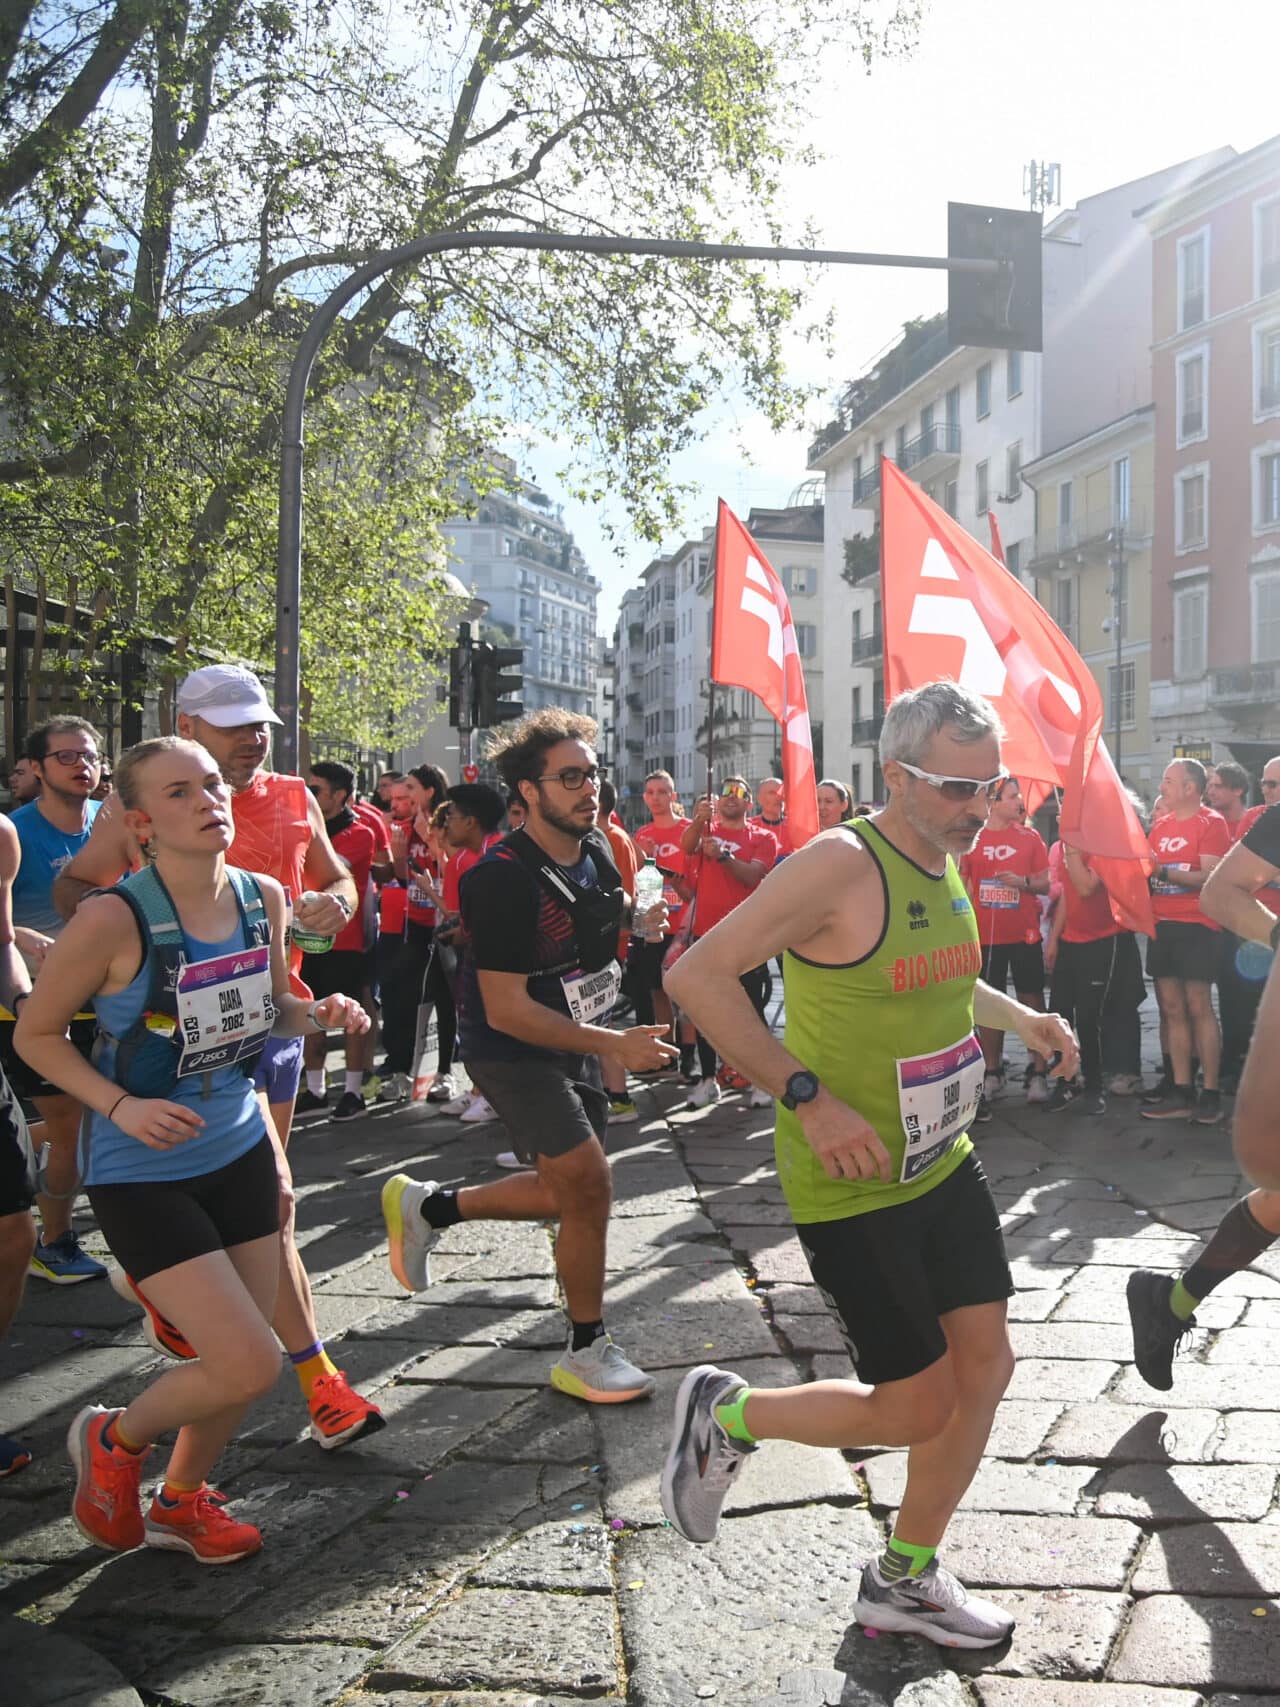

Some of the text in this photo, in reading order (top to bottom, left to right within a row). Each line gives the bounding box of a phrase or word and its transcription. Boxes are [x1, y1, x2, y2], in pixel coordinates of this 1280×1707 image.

[893, 954, 929, 993] BIO
[218, 987, 243, 1013] CIARA
[221, 1012, 245, 1033] 2082
[202, 1049, 228, 1064] asics
[944, 1080, 960, 1110] FABIO
